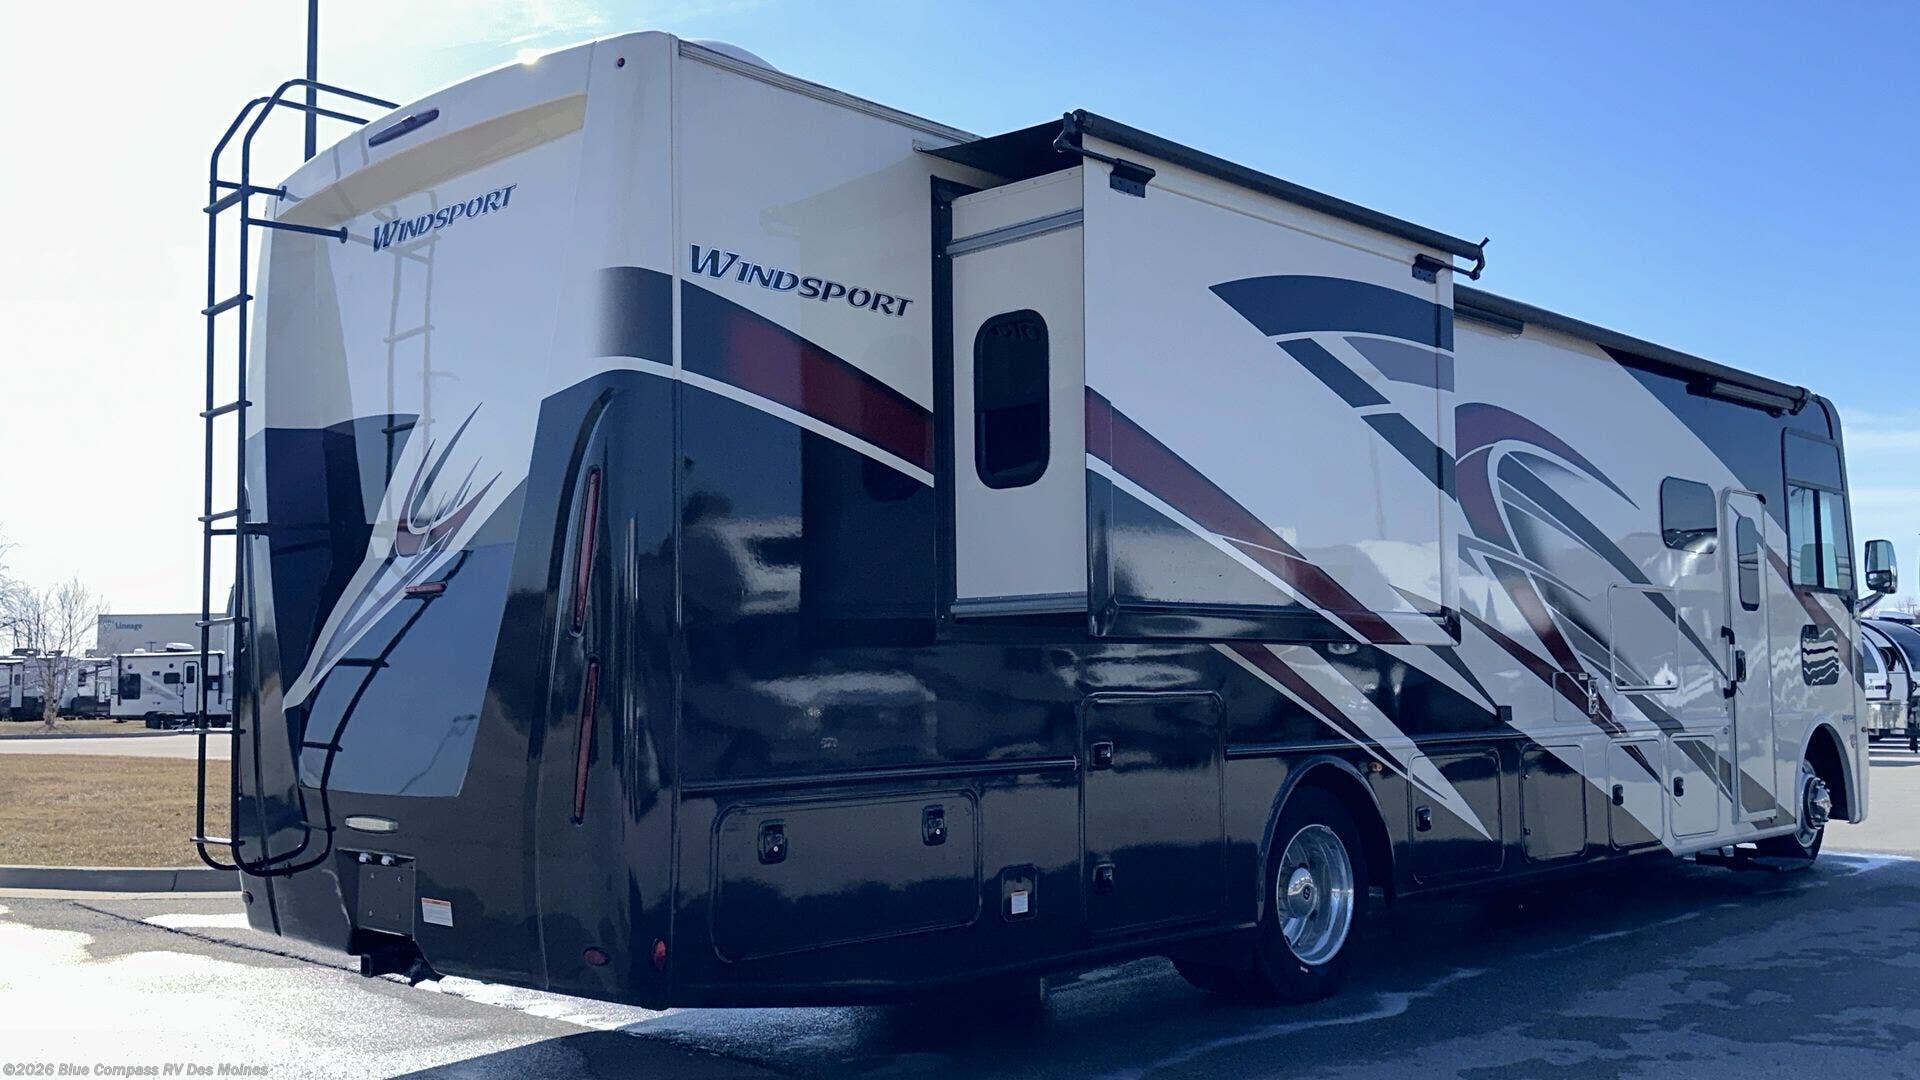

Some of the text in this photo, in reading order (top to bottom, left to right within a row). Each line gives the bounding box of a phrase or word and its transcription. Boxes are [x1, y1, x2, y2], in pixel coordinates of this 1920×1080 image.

[373, 183, 517, 252] WINDSPORT
[689, 242, 914, 318] WINDSPORT
[115, 621, 143, 631] Lineage
